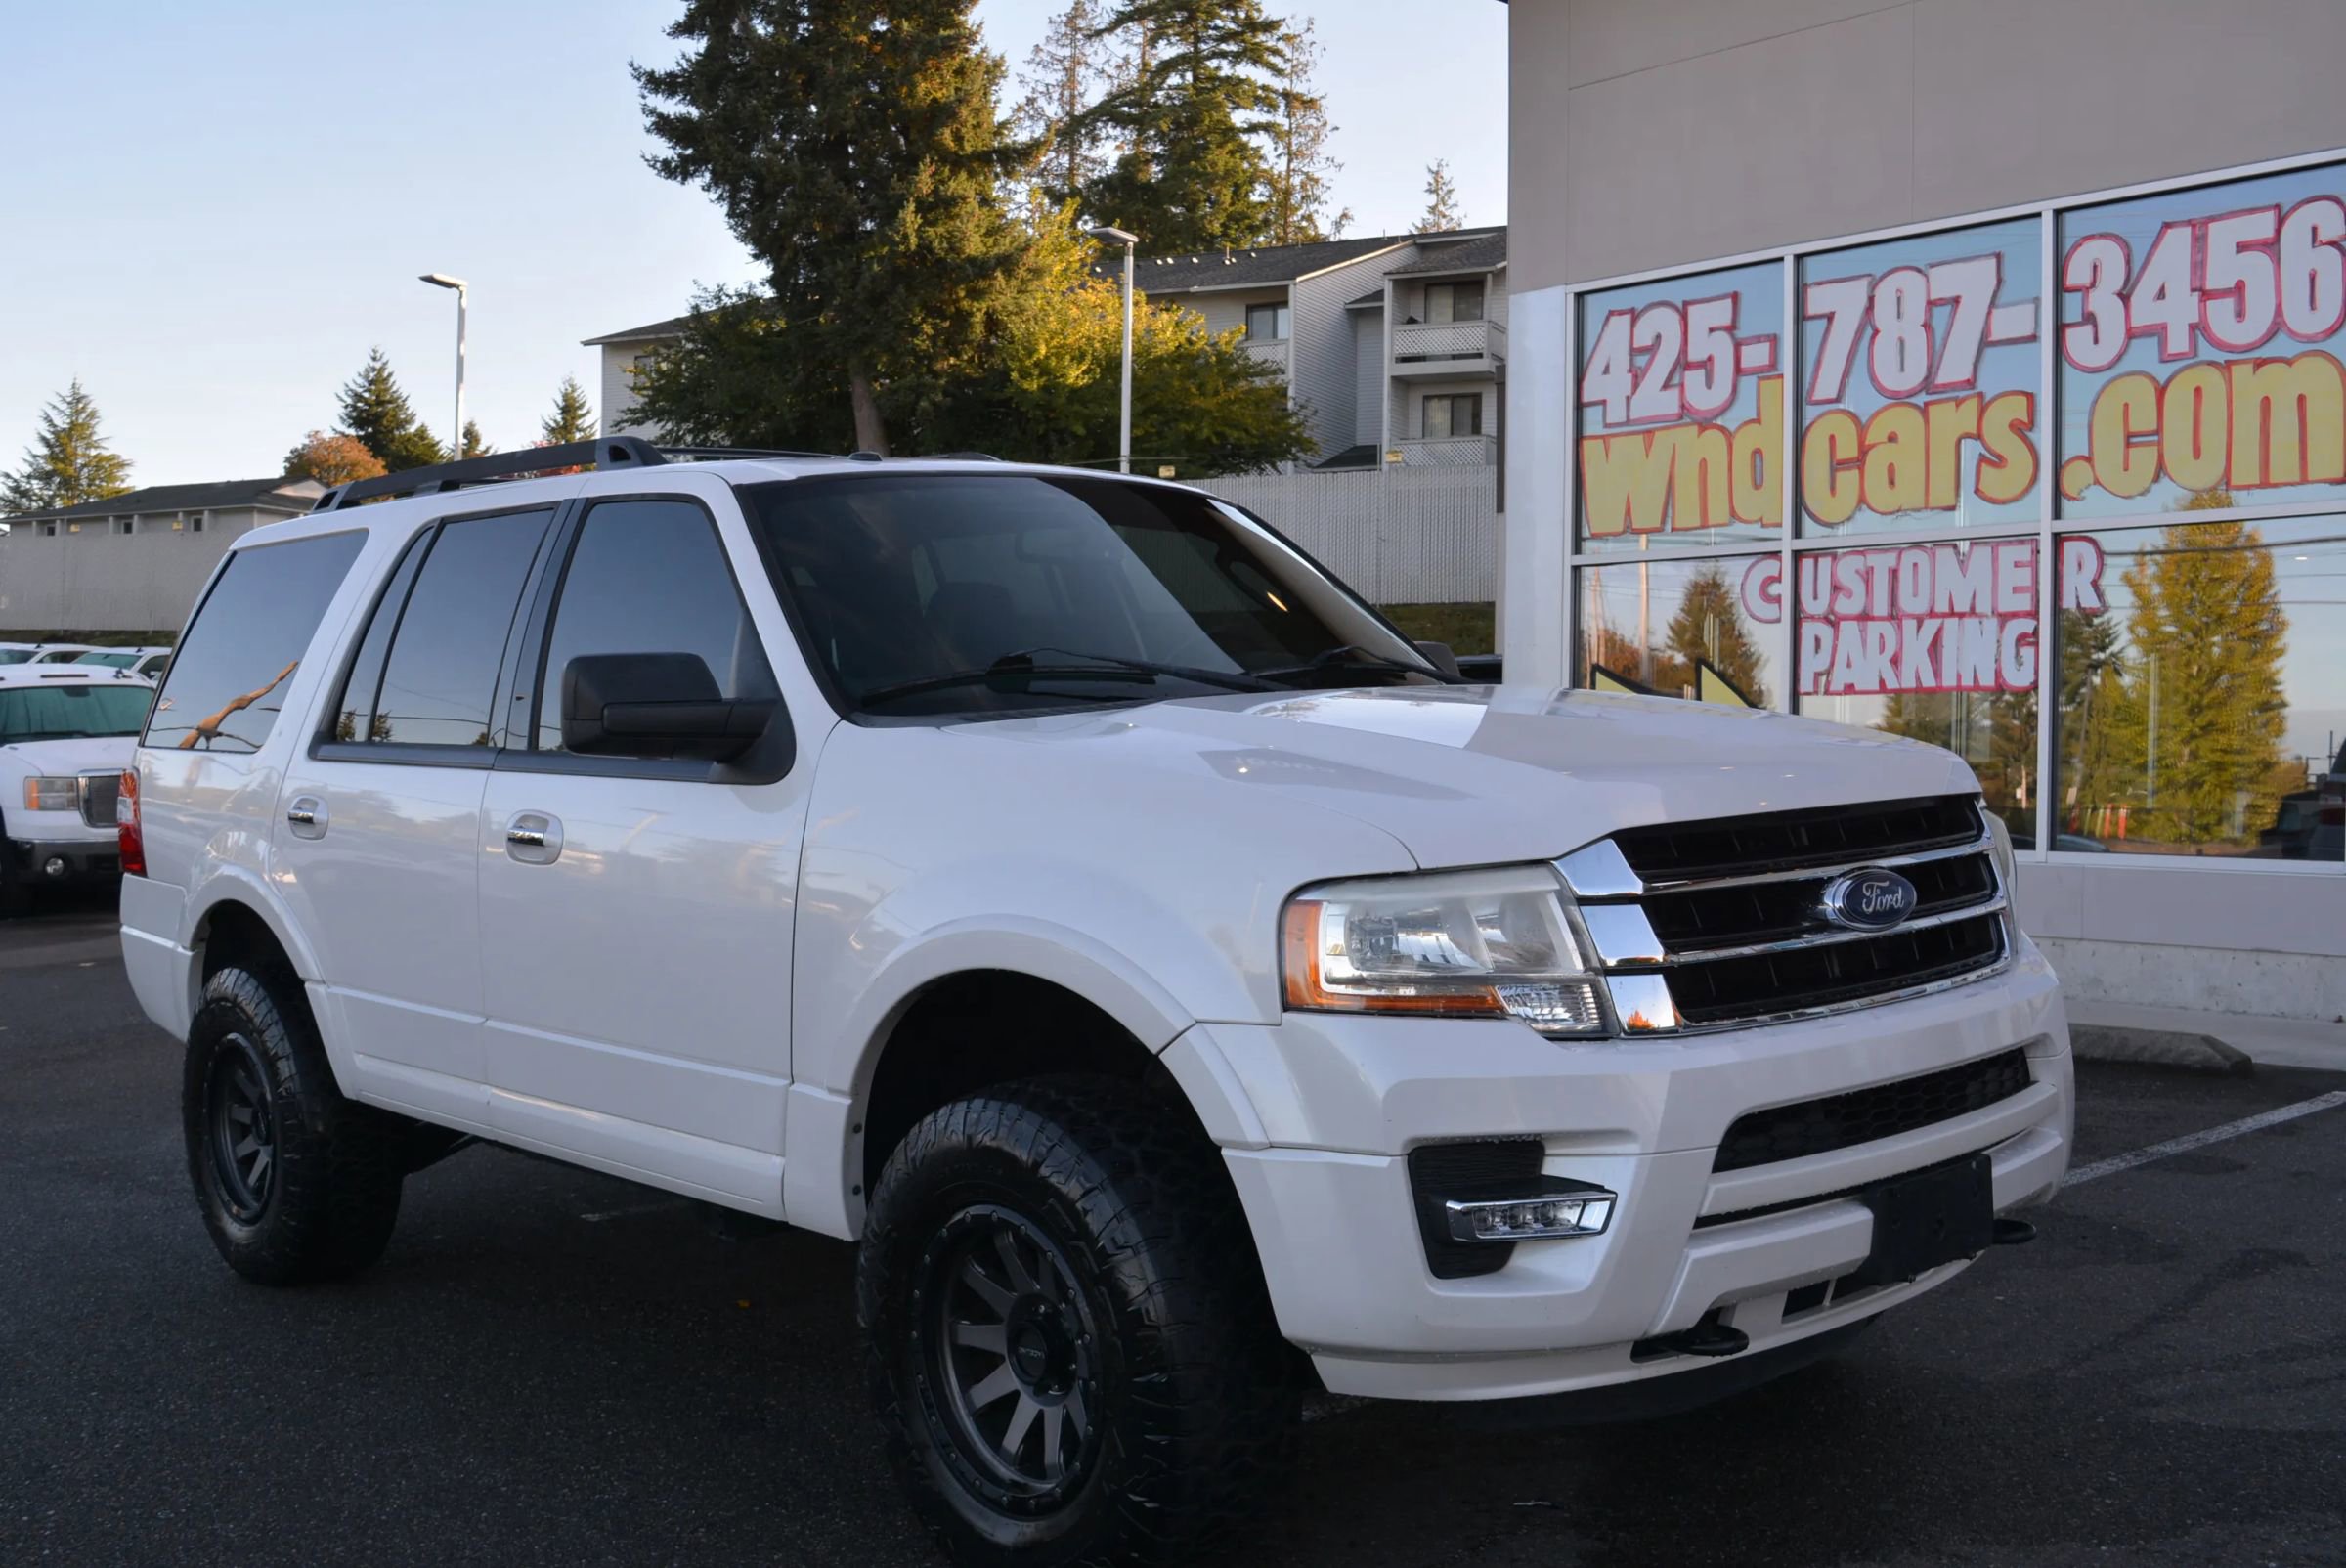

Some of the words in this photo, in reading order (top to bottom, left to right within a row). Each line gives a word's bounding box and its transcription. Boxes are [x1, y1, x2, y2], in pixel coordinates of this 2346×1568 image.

[1740, 535, 2108, 624] CUSTOMER
[1798, 616, 2040, 695] PARKING
[1862, 881, 1904, 914] Ford
